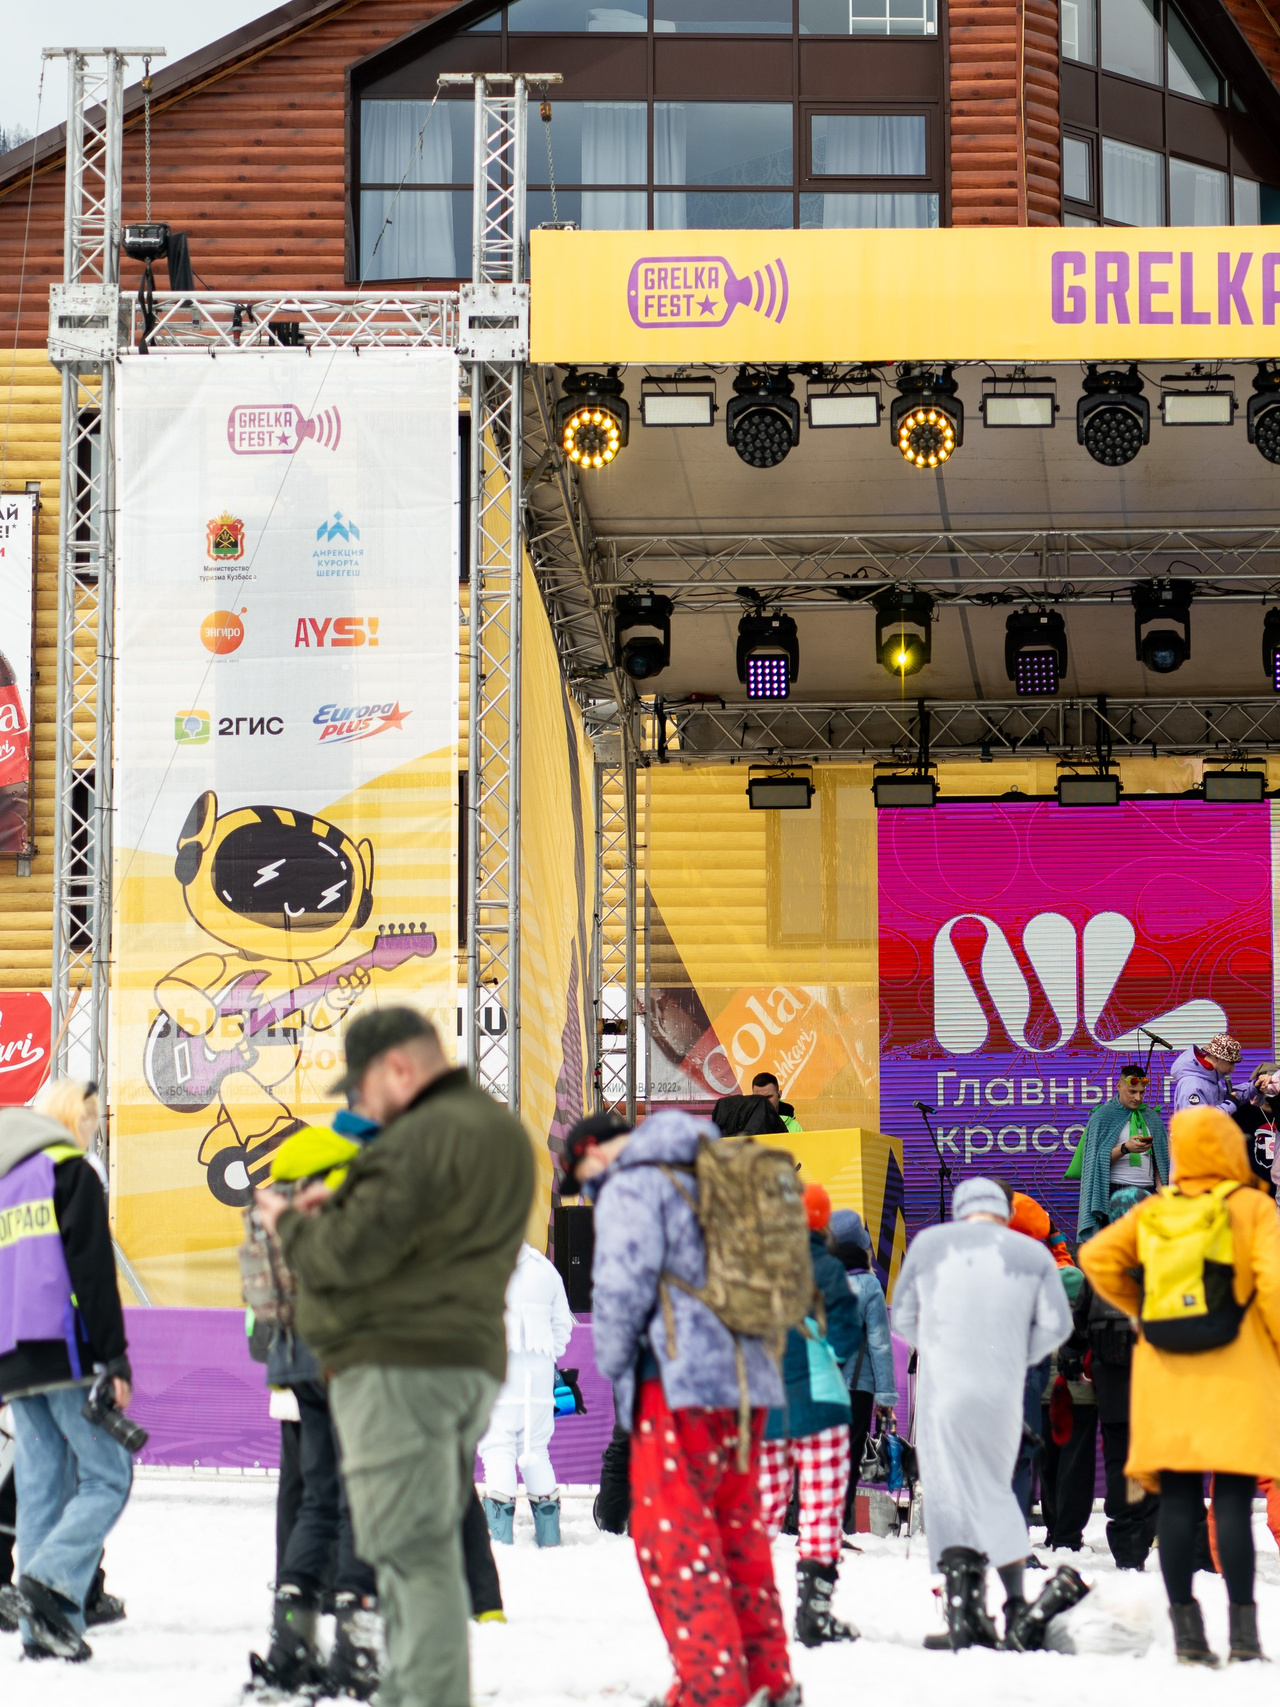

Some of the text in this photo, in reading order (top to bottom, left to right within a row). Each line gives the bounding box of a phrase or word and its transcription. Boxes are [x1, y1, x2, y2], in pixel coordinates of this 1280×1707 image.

[644, 266, 719, 290] GRELKA
[644, 294, 695, 318] FEST
[239, 411, 292, 428] GRELKA
[239, 430, 275, 448] FEST
[312, 549, 364, 558] ДИРЕКЦИЯ
[317, 559, 360, 567] КУРОРТА
[203, 565, 250, 573] Министерство
[316, 569, 361, 577] ШЕРЕГЕШ
[205, 627, 241, 640] энгиро
[294, 617, 379, 648] AYS!
[312, 702, 395, 725] Europa
[218, 716, 284, 736] 2ГИС
[148, 1007, 346, 1038] ВЫБИРА
[937, 1071, 1113, 1107] Главны
[936, 1123, 1086, 1164] красо
